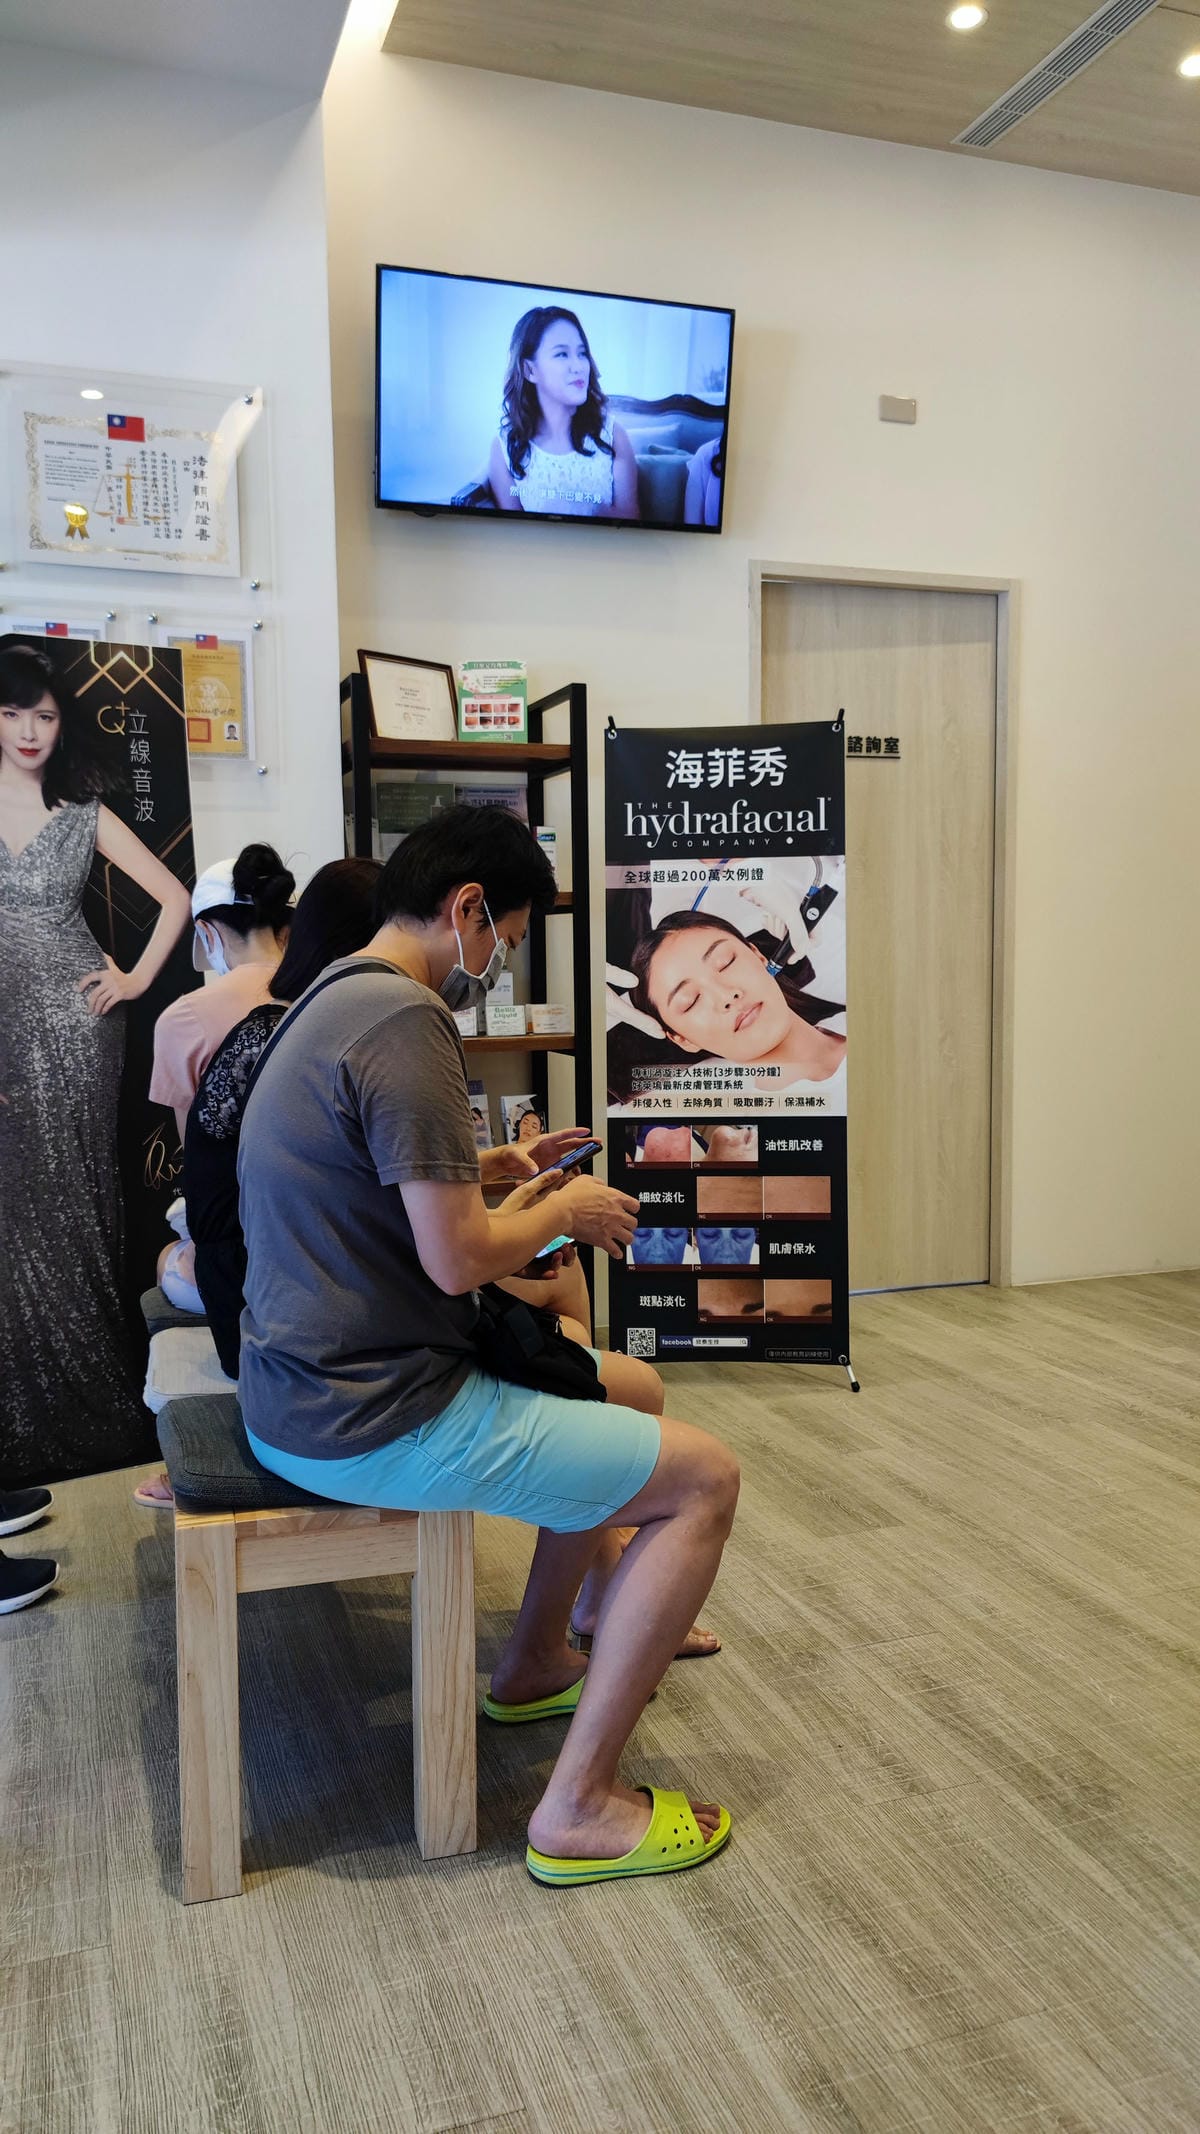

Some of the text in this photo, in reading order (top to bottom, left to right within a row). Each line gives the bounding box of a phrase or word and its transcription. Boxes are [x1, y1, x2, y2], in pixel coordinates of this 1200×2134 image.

[847, 735, 900, 754] 諮詢室
[128, 709, 156, 823] 立線音波
[665, 746, 788, 790] 海菲秀
[637, 801, 673, 810] THE
[623, 796, 829, 849] hydrafacial
[672, 838, 771, 848] COMPANY
[624, 867, 765, 885] 全球超過200萬次例證
[632, 1098, 673, 1108] 非侵入性
[683, 1097, 723, 1108] 去除角質
[784, 1096, 826, 1107] 保濕補水
[764, 1139, 824, 1152] 油性肌改善
[638, 1191, 685, 1204] 細紋淡化
[768, 1242, 817, 1255] 肌膚保水
[639, 1295, 686, 1308] 斑點淡化
[661, 1338, 692, 1347] facebook
